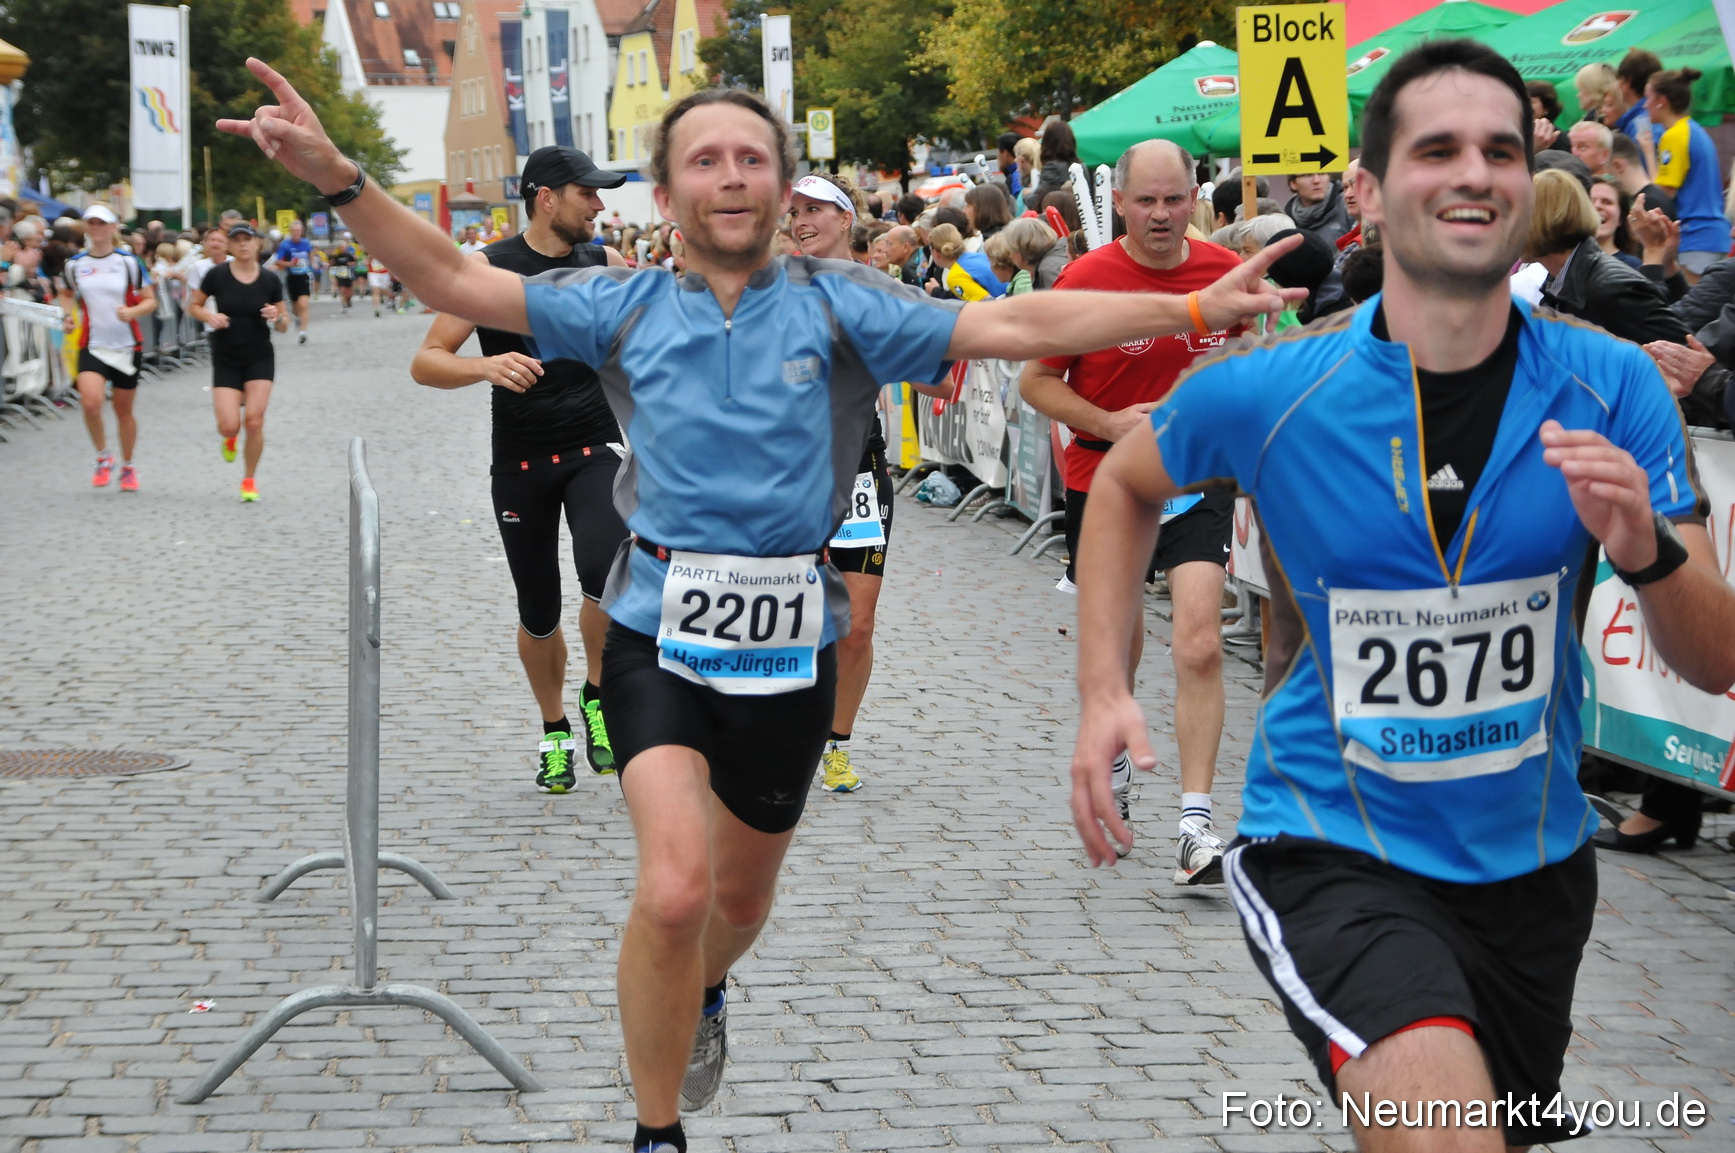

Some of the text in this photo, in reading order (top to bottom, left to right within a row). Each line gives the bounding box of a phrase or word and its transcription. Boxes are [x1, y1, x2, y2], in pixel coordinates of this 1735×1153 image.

[1253, 12, 1335, 42] Block
[1265, 57, 1326, 137] A
[1427, 480, 1464, 489] adidas
[672, 565, 800, 585] PARTL Neumarkt
[679, 588, 805, 643] 2201
[1335, 600, 1519, 627] PARTL Neumarkt
[666, 628, 673, 637] B
[1358, 623, 1535, 707] 2679
[1345, 701, 1353, 714] C
[1380, 719, 1520, 756] Sebastian
